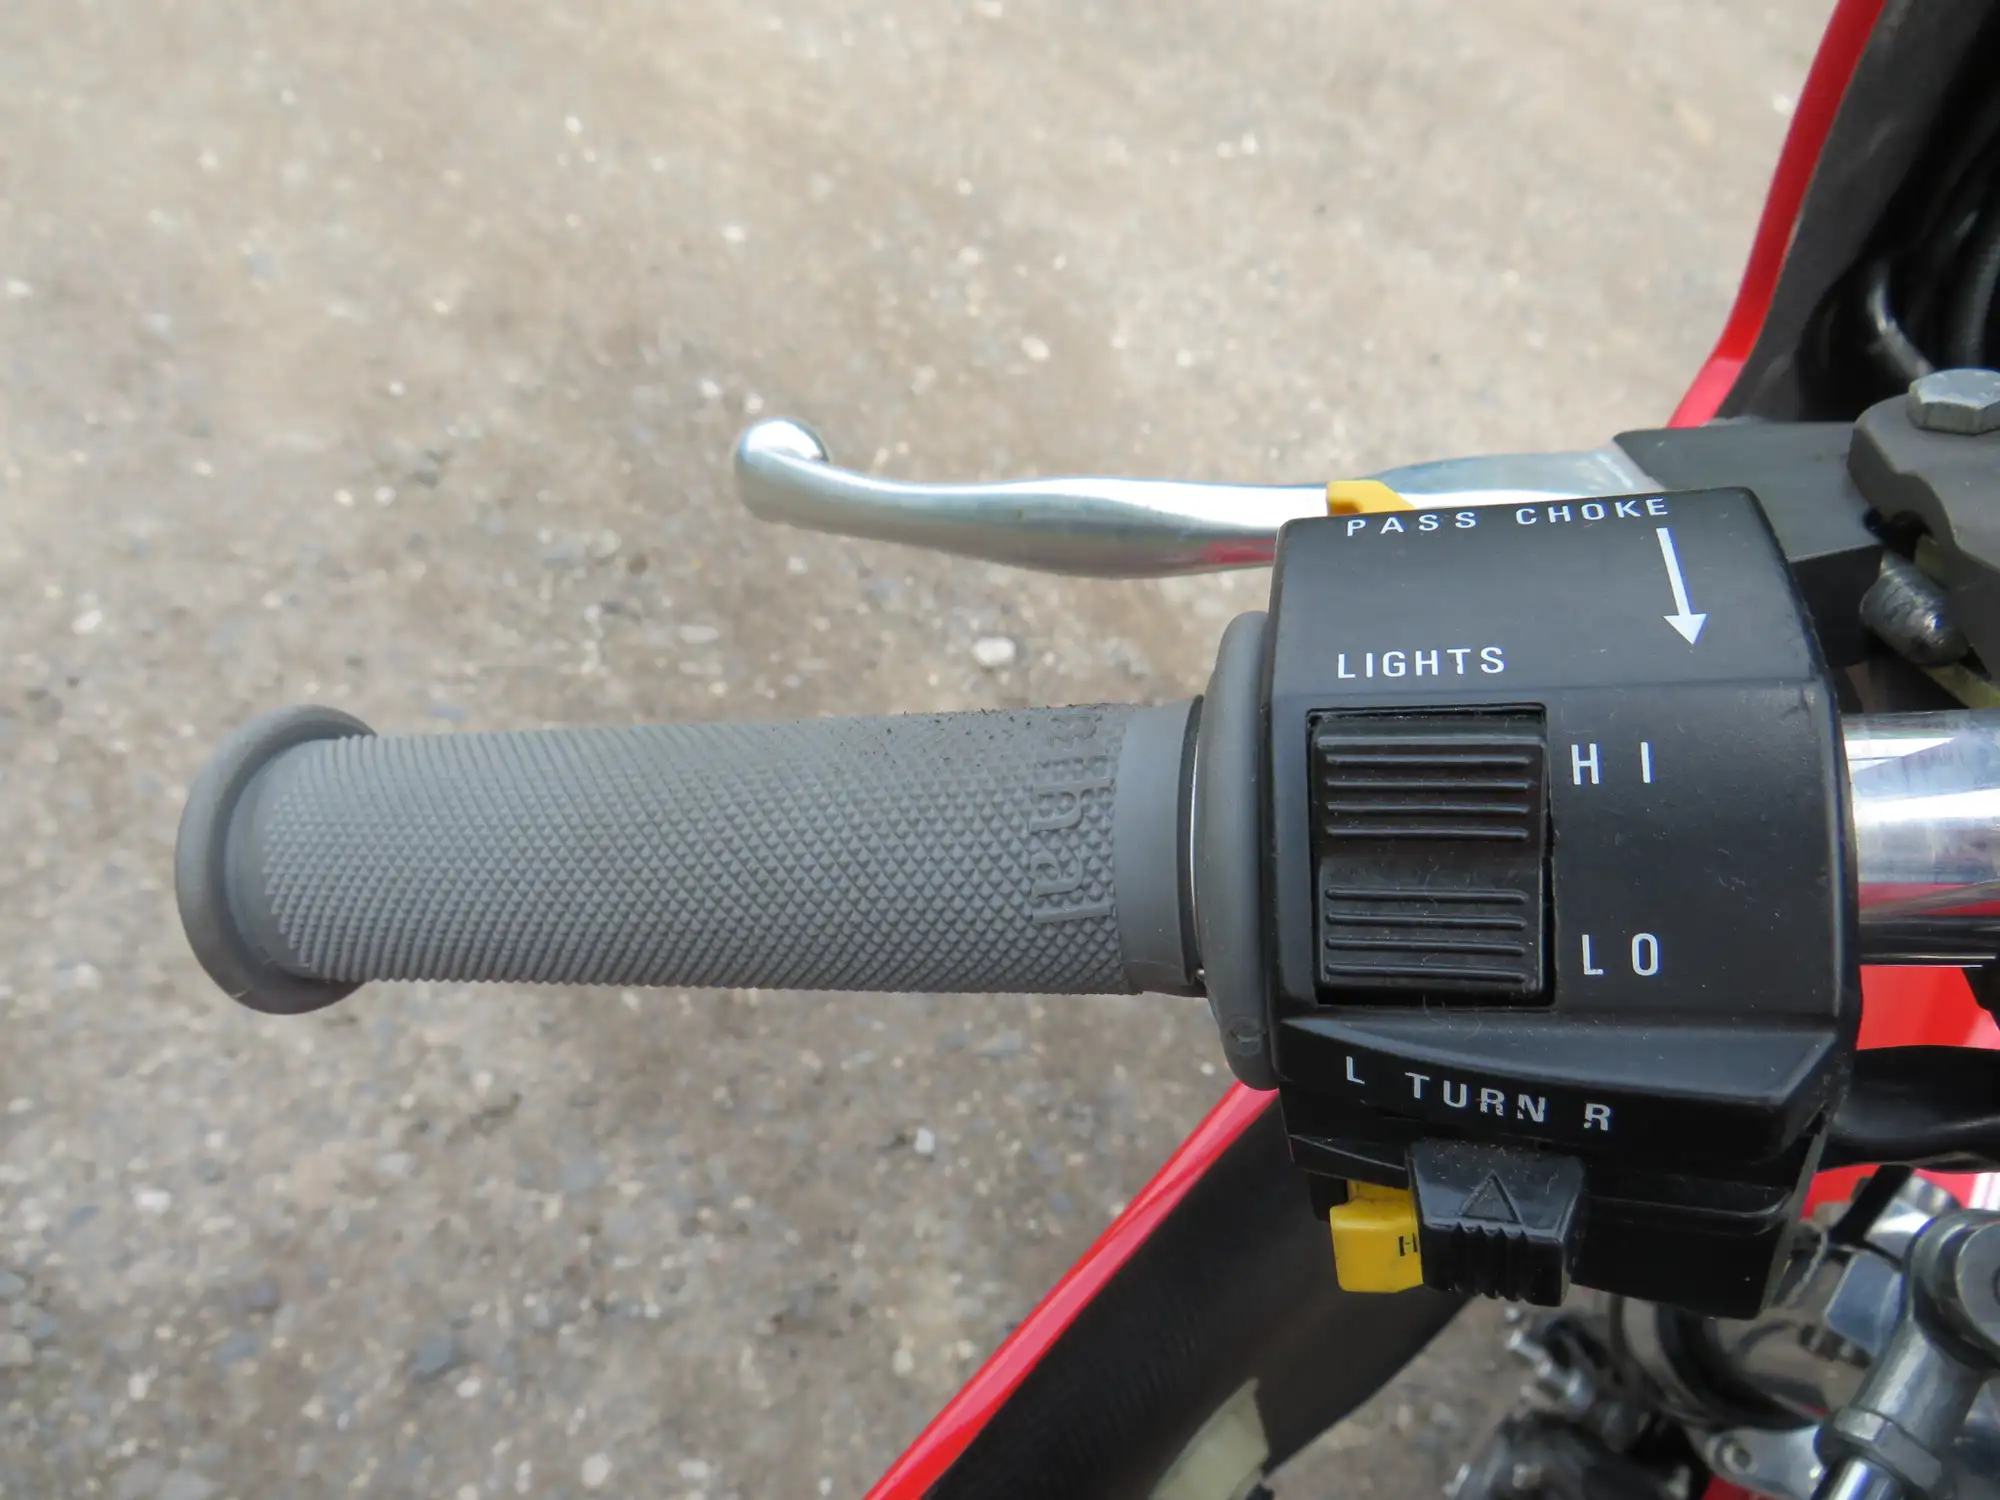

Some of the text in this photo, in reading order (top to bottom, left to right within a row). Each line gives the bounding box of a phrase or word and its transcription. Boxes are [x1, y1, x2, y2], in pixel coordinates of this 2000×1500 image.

[1346, 498, 1669, 537] PASS CHOKE
[1337, 643, 1510, 680] LIGHTS
[1570, 741, 1655, 786] HI
[1581, 932, 1661, 977] LO
[1345, 1055, 1613, 1132] L TURN R
